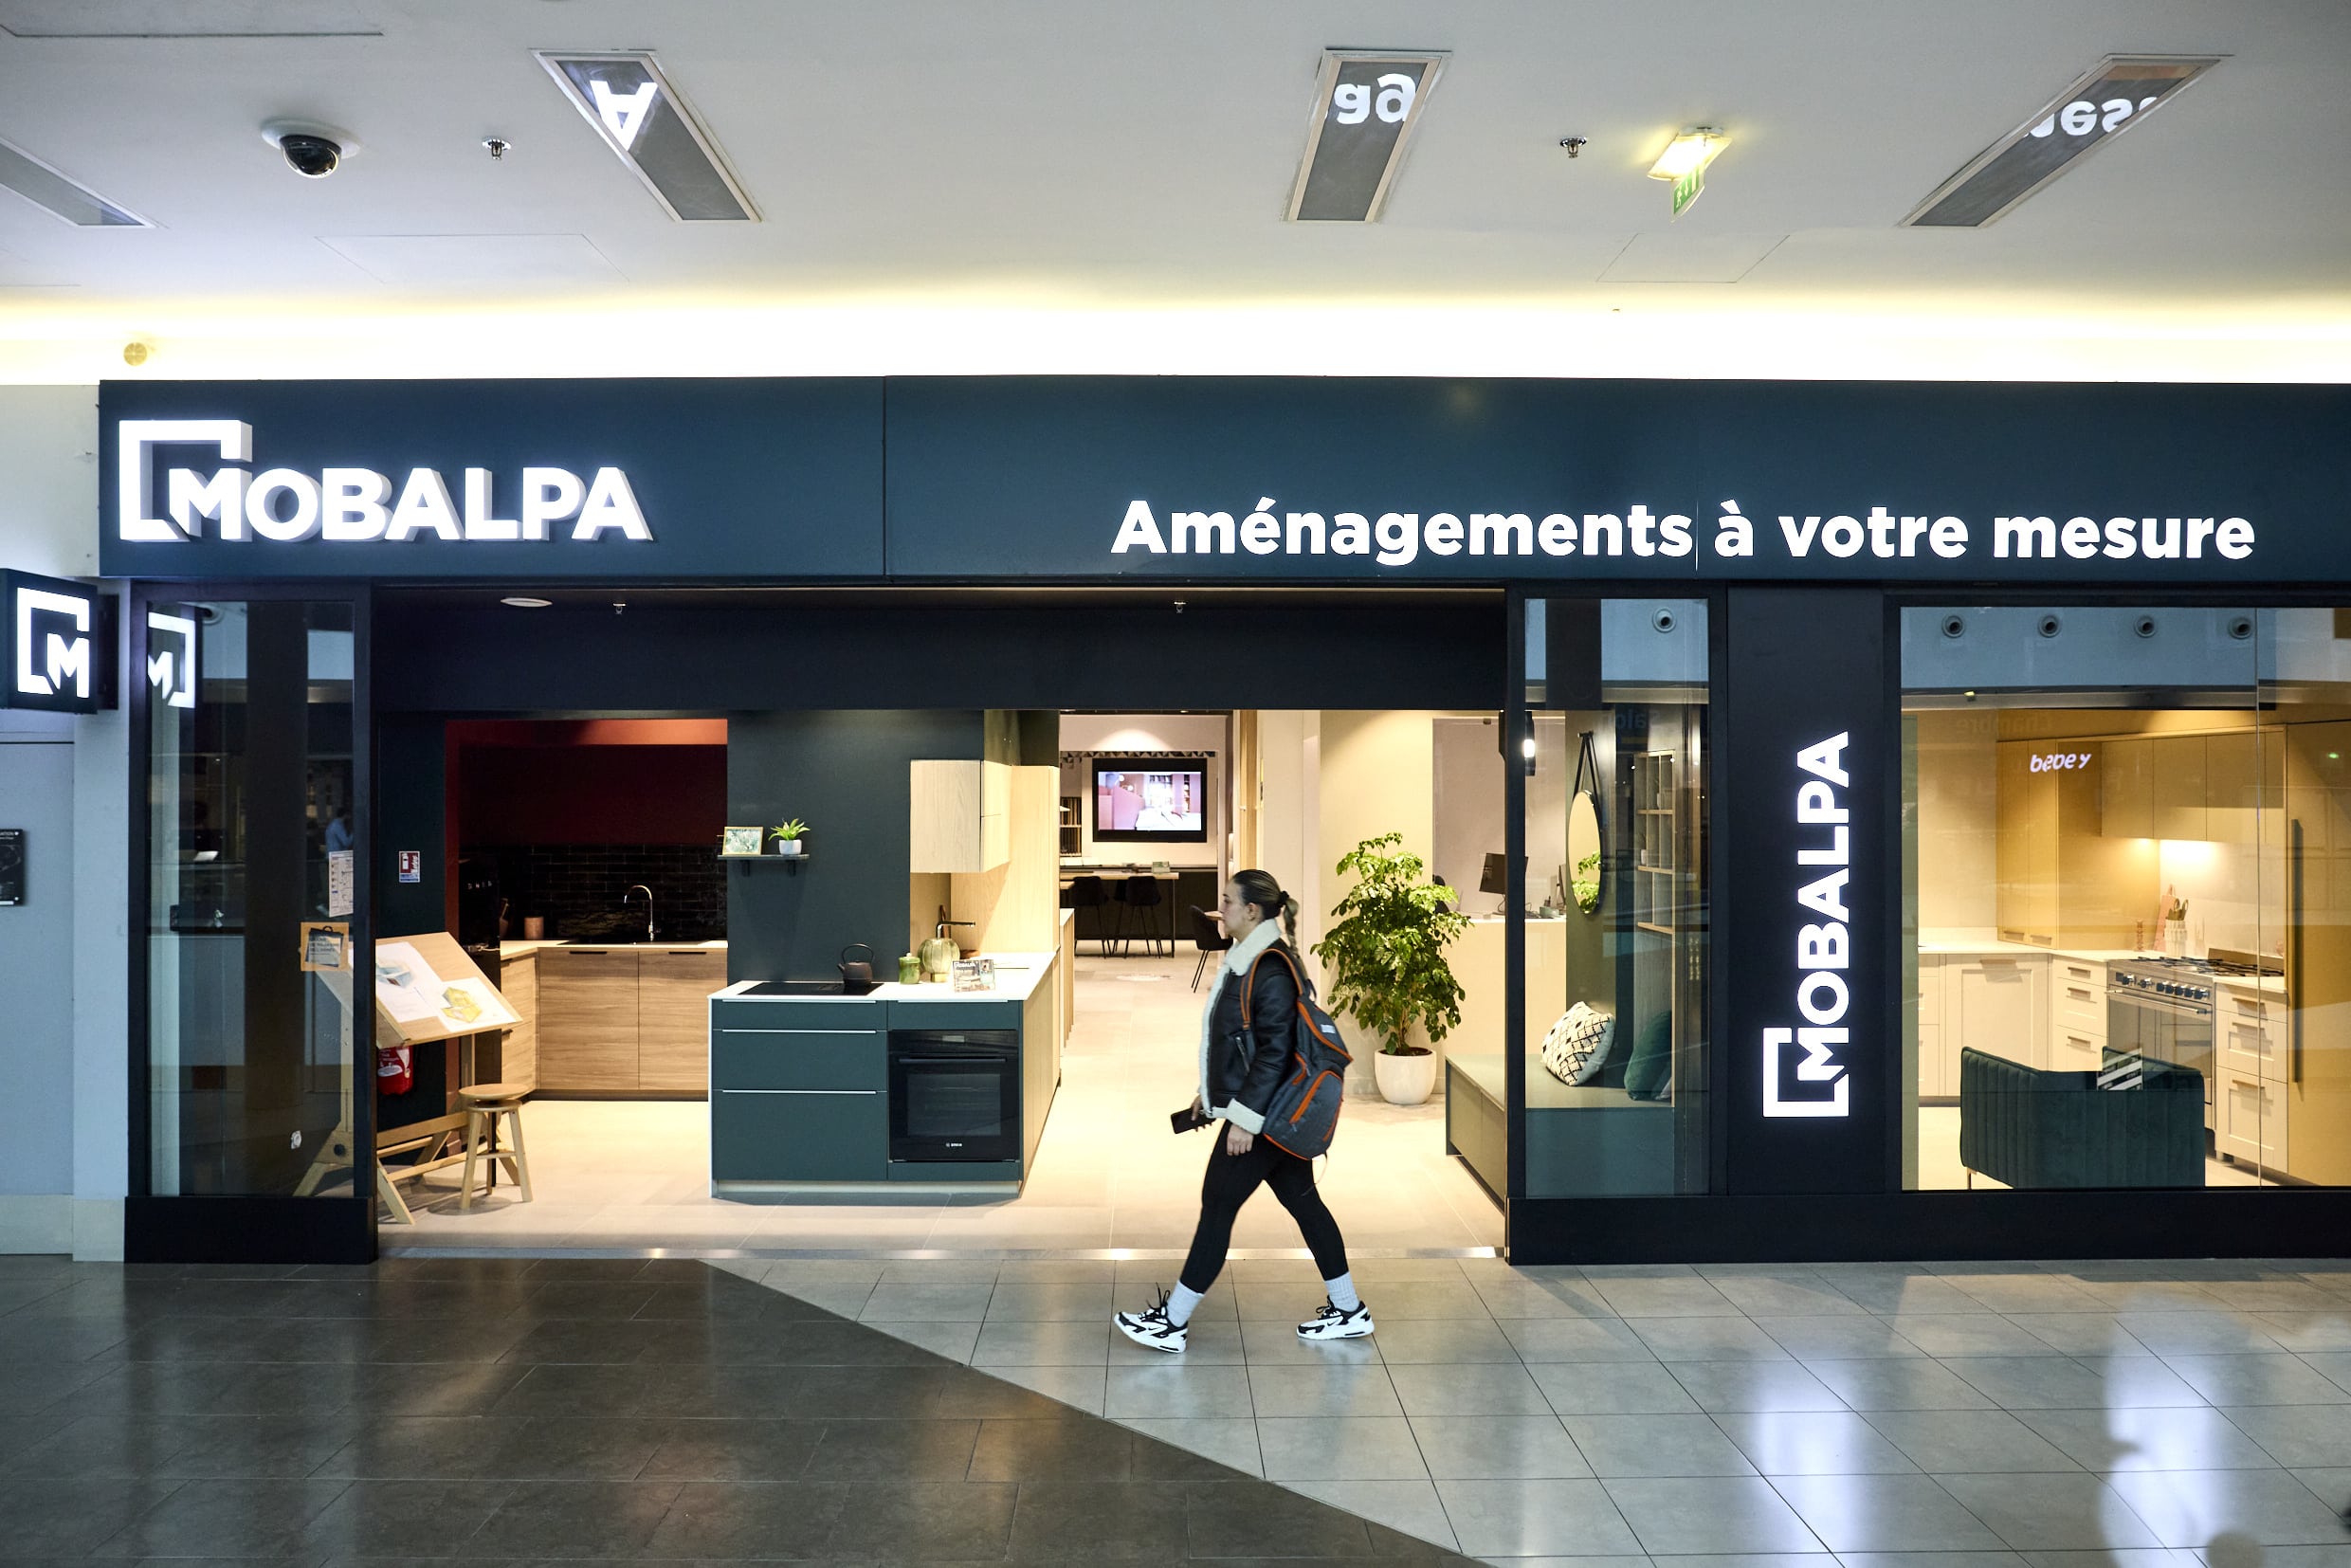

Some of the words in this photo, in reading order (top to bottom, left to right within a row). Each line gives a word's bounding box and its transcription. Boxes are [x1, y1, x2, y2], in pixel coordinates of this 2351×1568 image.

[168, 465, 653, 542] MOBALPA
[1111, 497, 1693, 567] Aménagements
[1714, 500, 1754, 557] à
[1778, 507, 1969, 558] votre
[1994, 517, 2255, 559] mesure
[1796, 731, 1850, 1082] MOBALPA
